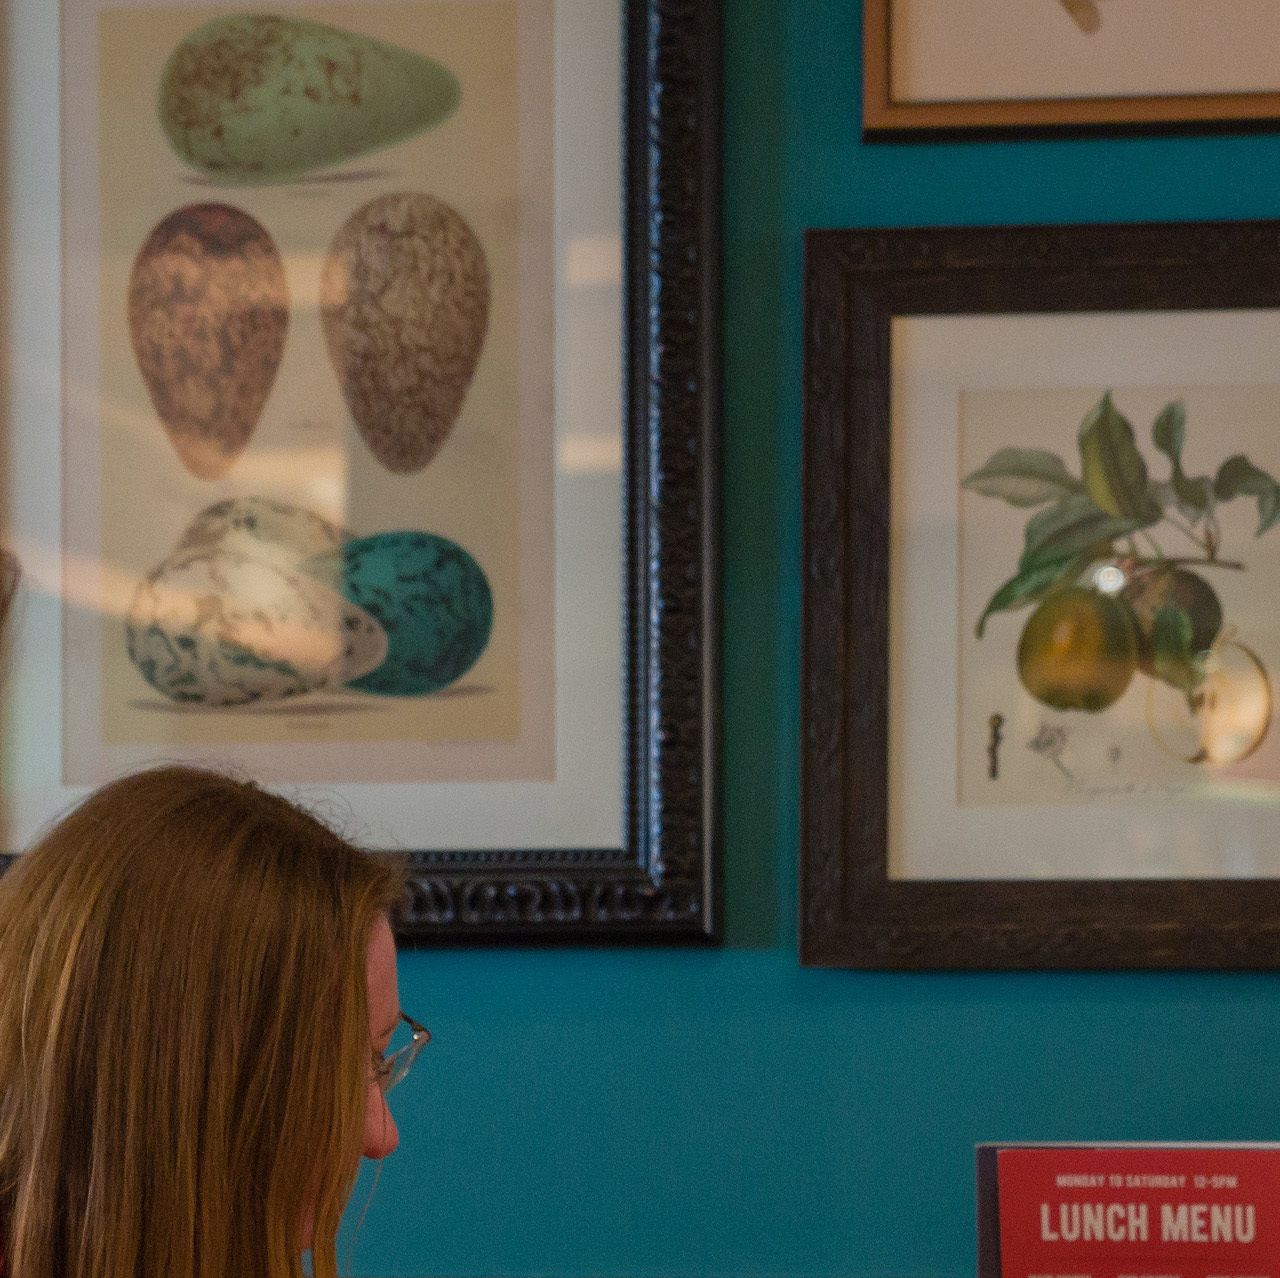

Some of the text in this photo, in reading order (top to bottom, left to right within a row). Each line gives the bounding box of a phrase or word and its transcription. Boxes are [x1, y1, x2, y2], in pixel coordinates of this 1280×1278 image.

[1056, 1174, 1104, 1188] MONDAY
[1109, 1175, 1123, 1188] TO
[1125, 1175, 1186, 1188] SATURDAY
[1040, 1202, 1256, 1243] LUNCH MENU
